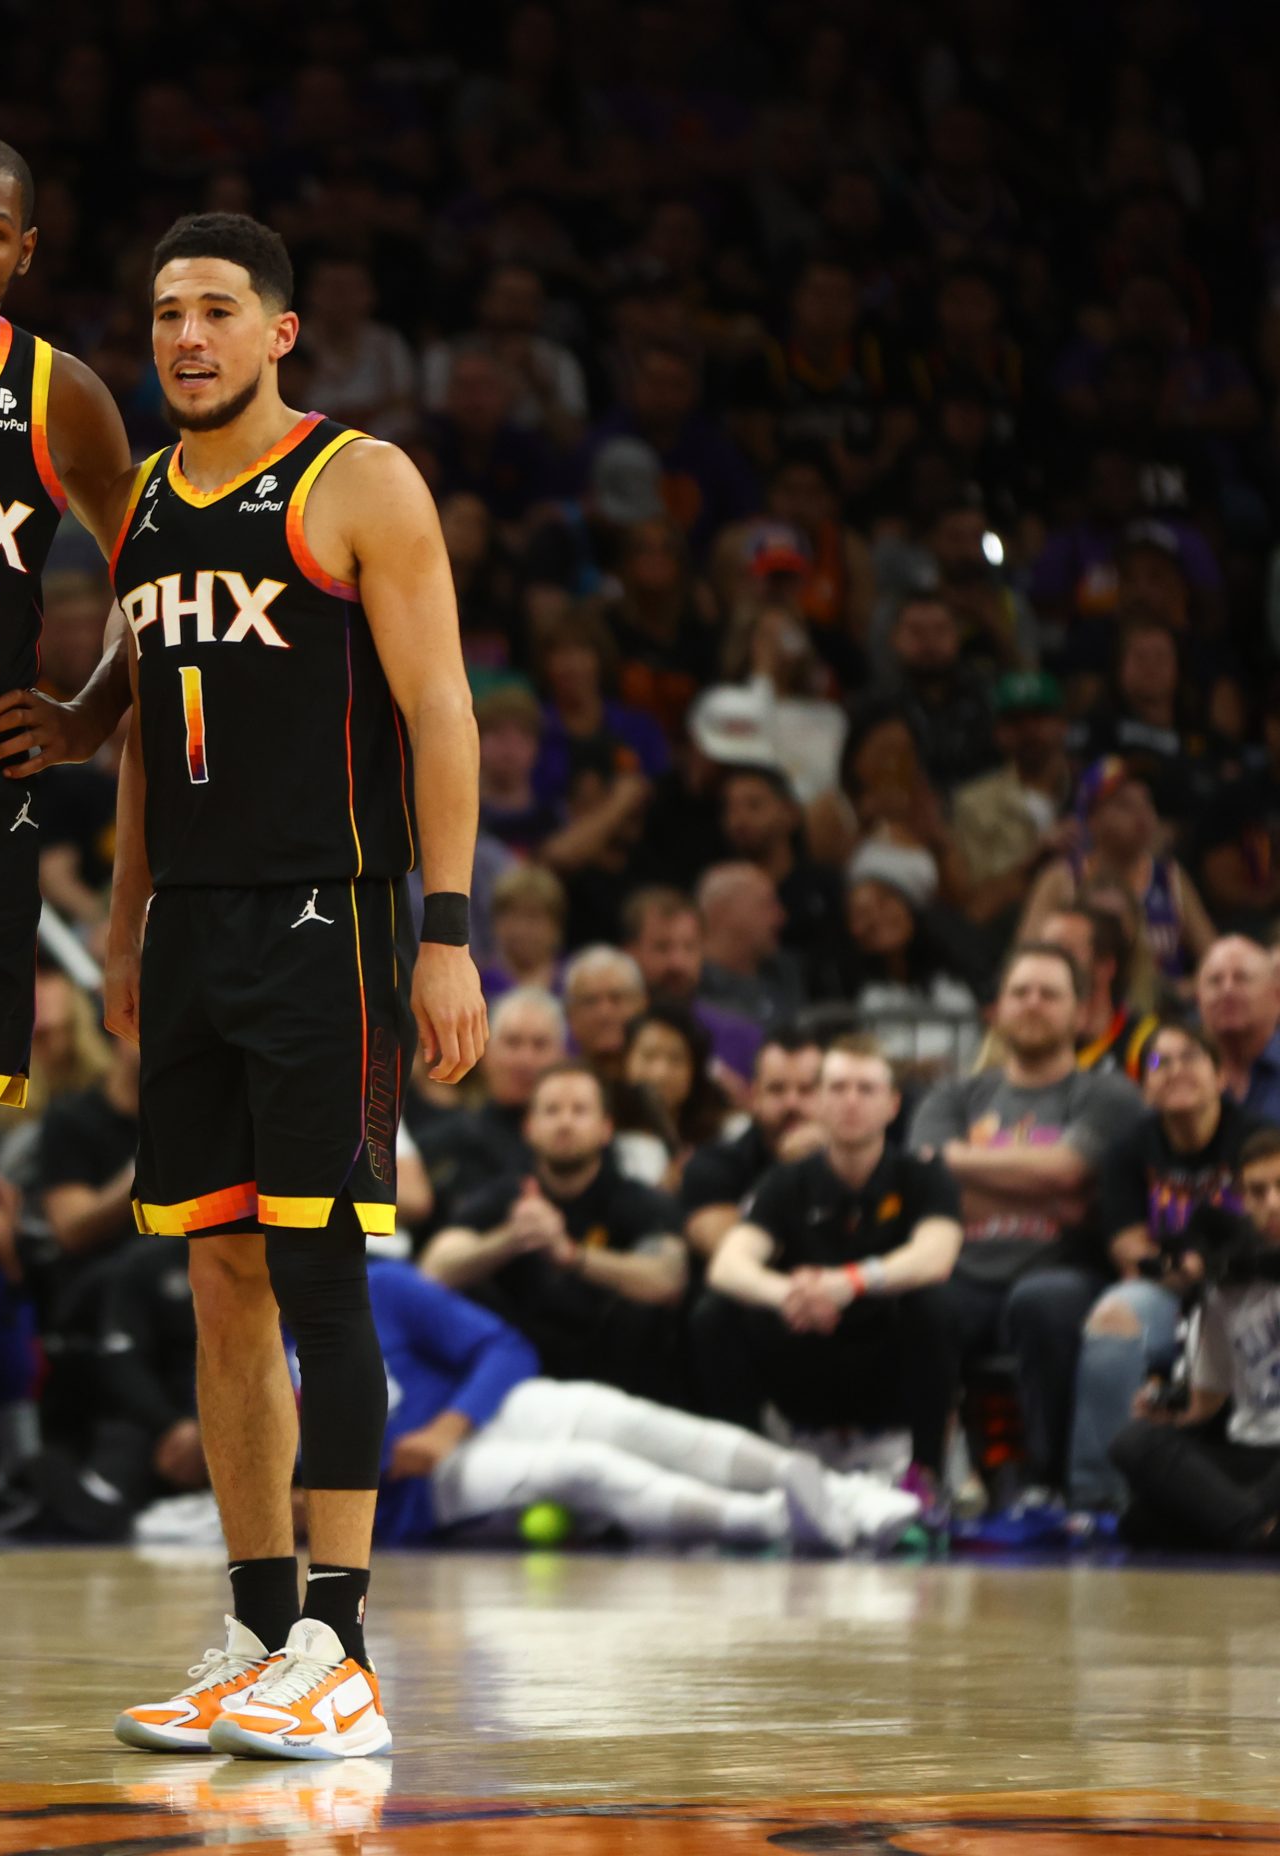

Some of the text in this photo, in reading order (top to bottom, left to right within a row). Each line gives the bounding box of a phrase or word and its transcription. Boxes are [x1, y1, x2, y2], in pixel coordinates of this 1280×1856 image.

[144, 476, 162, 499] 6
[238, 500, 284, 513] PayPal
[120, 569, 292, 660] PHX
[178, 665, 210, 784] 1
